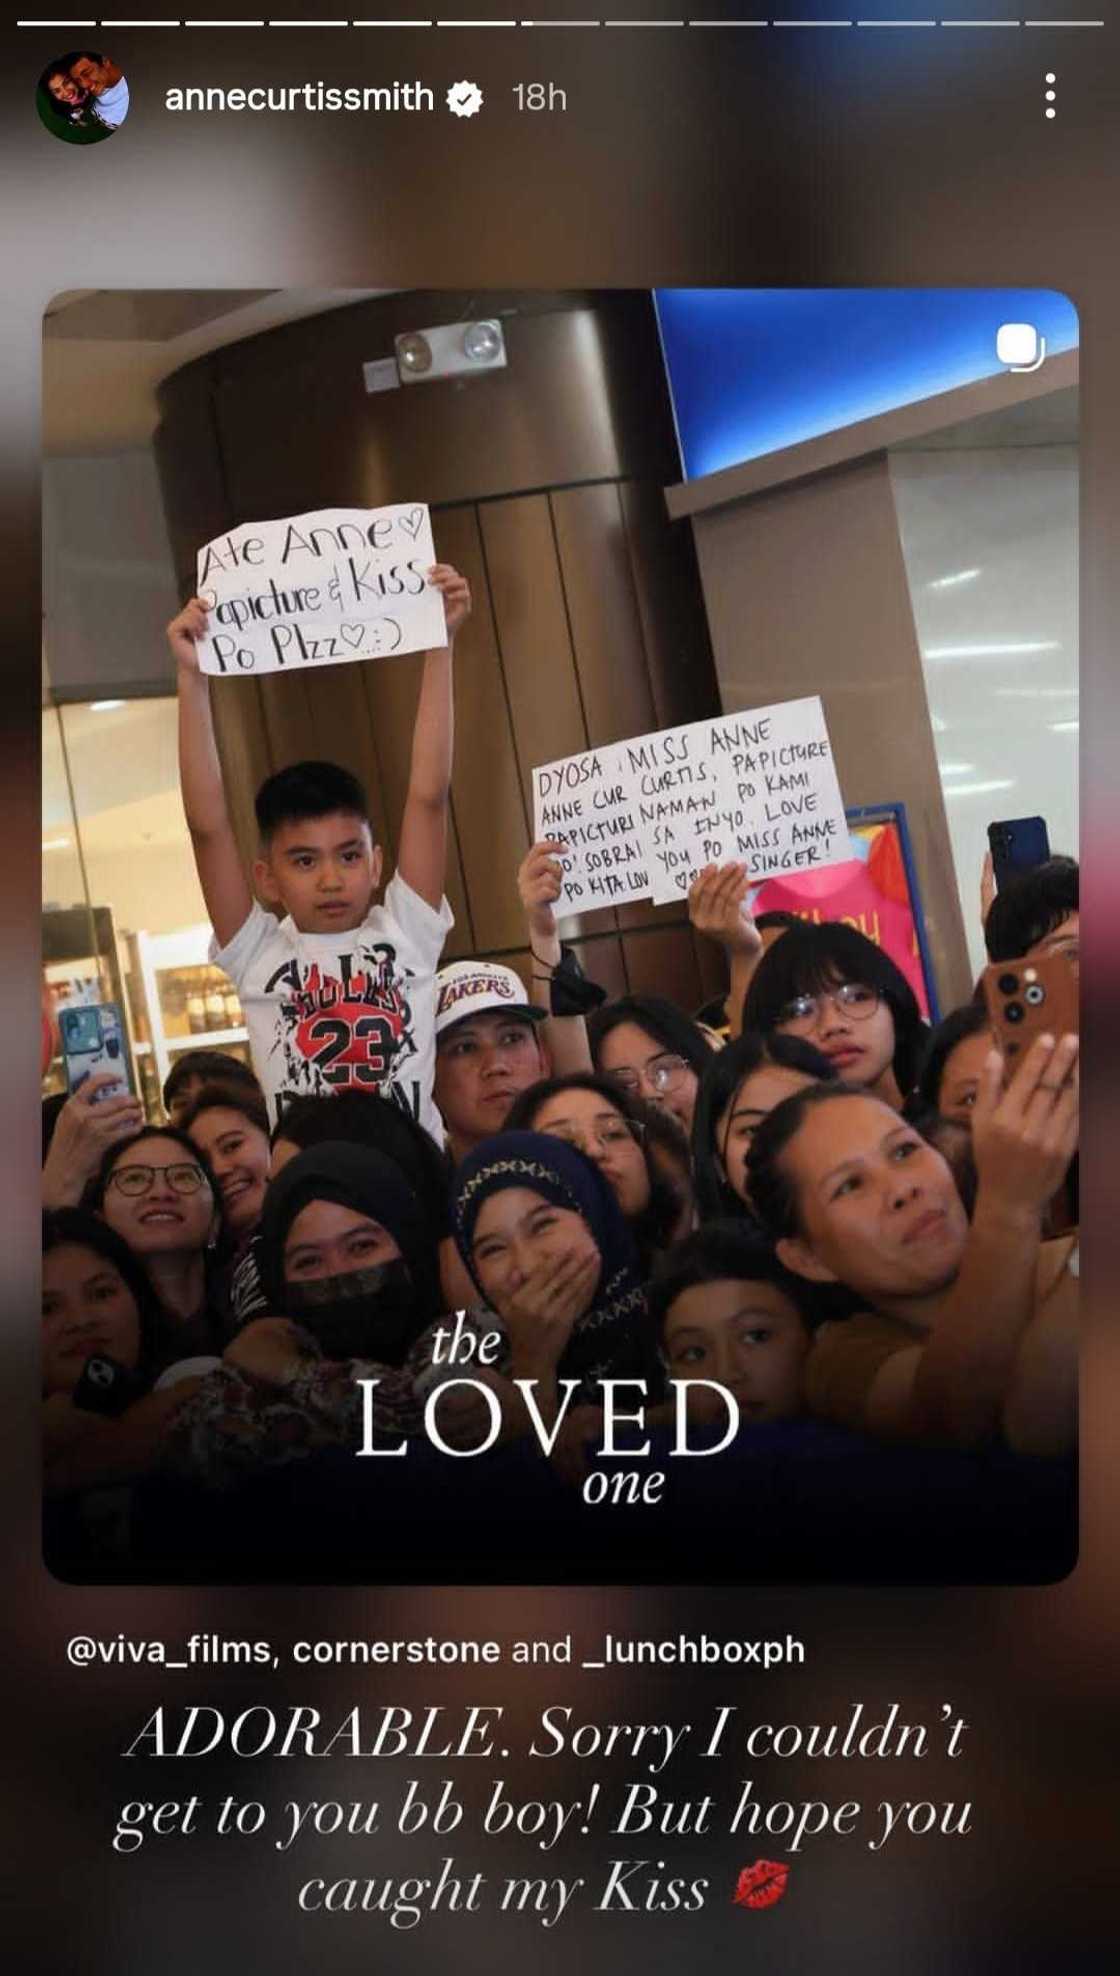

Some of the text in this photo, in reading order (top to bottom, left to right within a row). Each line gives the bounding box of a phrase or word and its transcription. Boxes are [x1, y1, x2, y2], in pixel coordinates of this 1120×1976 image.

[200, 518, 393, 588] Ate Anne
[348, 557, 426, 601] Kiss
[212, 633, 255, 672] Po
[626, 718, 771, 774] MISS ANNE
[732, 740, 829, 776] PAPICTURE
[541, 800, 583, 827] ANNE
[639, 771, 809, 825] NAMAN PO KAMI
[653, 825, 675, 845] SA
[765, 792, 818, 822] LOVE
[656, 818, 837, 873] YOU PO MISS ANNE
[564, 881, 584, 903] PO
[588, 874, 624, 896] KITA
[434, 978, 516, 1017] LAKERS
[309, 1017, 399, 1085] 23
